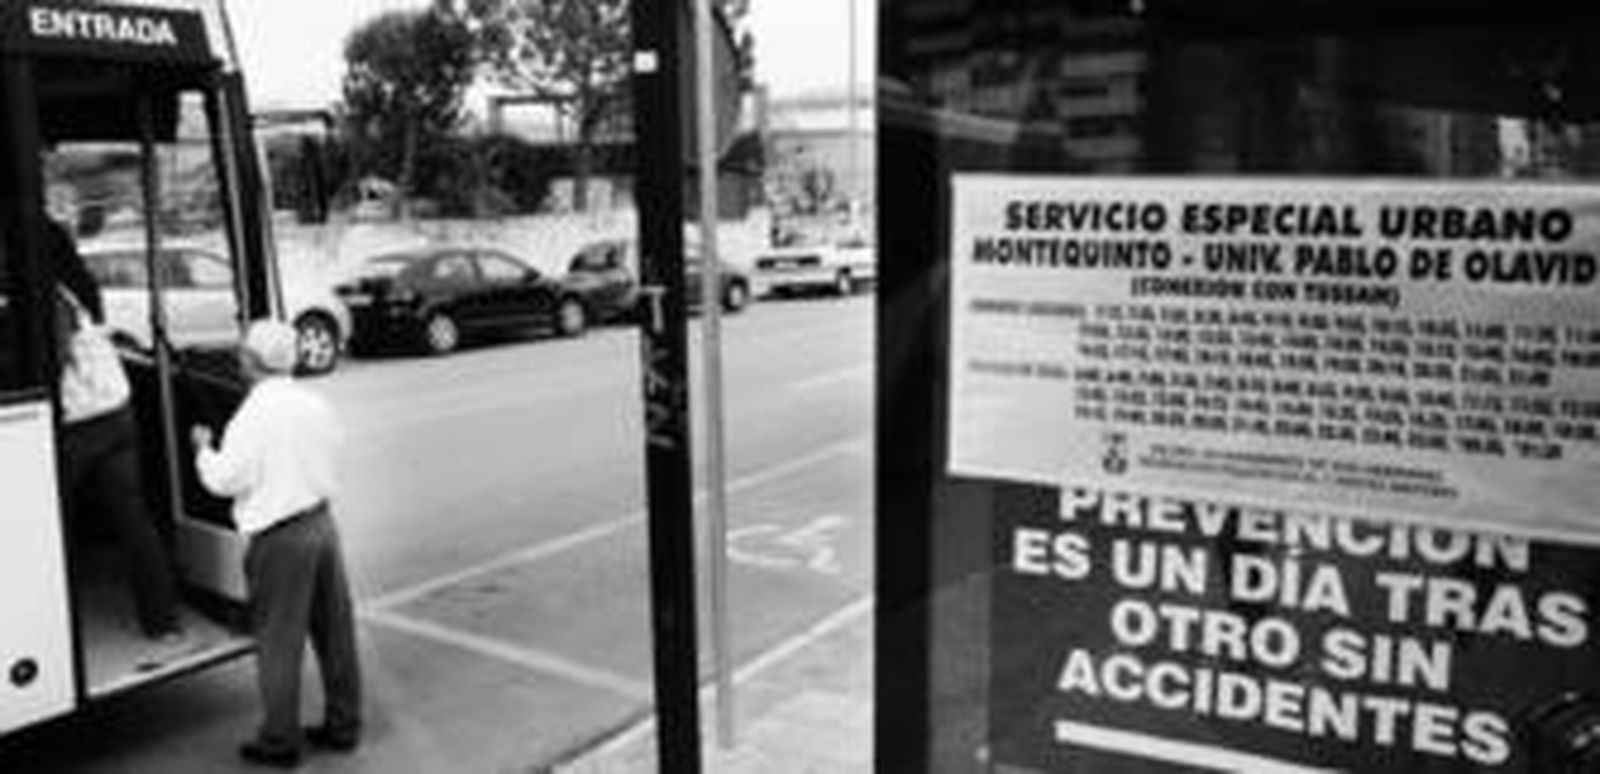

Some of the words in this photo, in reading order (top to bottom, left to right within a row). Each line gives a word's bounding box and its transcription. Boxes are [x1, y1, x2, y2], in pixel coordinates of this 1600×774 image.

[30, 7, 178, 46] ENTRADA
[1005, 201, 1168, 234] SERVICIO
[1182, 203, 1363, 237] ESPECIAL
[1379, 206, 1573, 243] URBANO
[972, 238, 1172, 270] MONTEQUINTO
[1296, 245, 1398, 280] PABLO
[1409, 249, 1452, 281] DE
[1012, 528, 1091, 579] ES
[1112, 540, 1207, 593] UN
[1231, 547, 1350, 616] DÍA
[1376, 572, 1589, 647] TRAS
[1110, 600, 1300, 667] OTRO
[1321, 628, 1452, 691] SIN
[1057, 648, 1511, 765] ACCIDENTES
